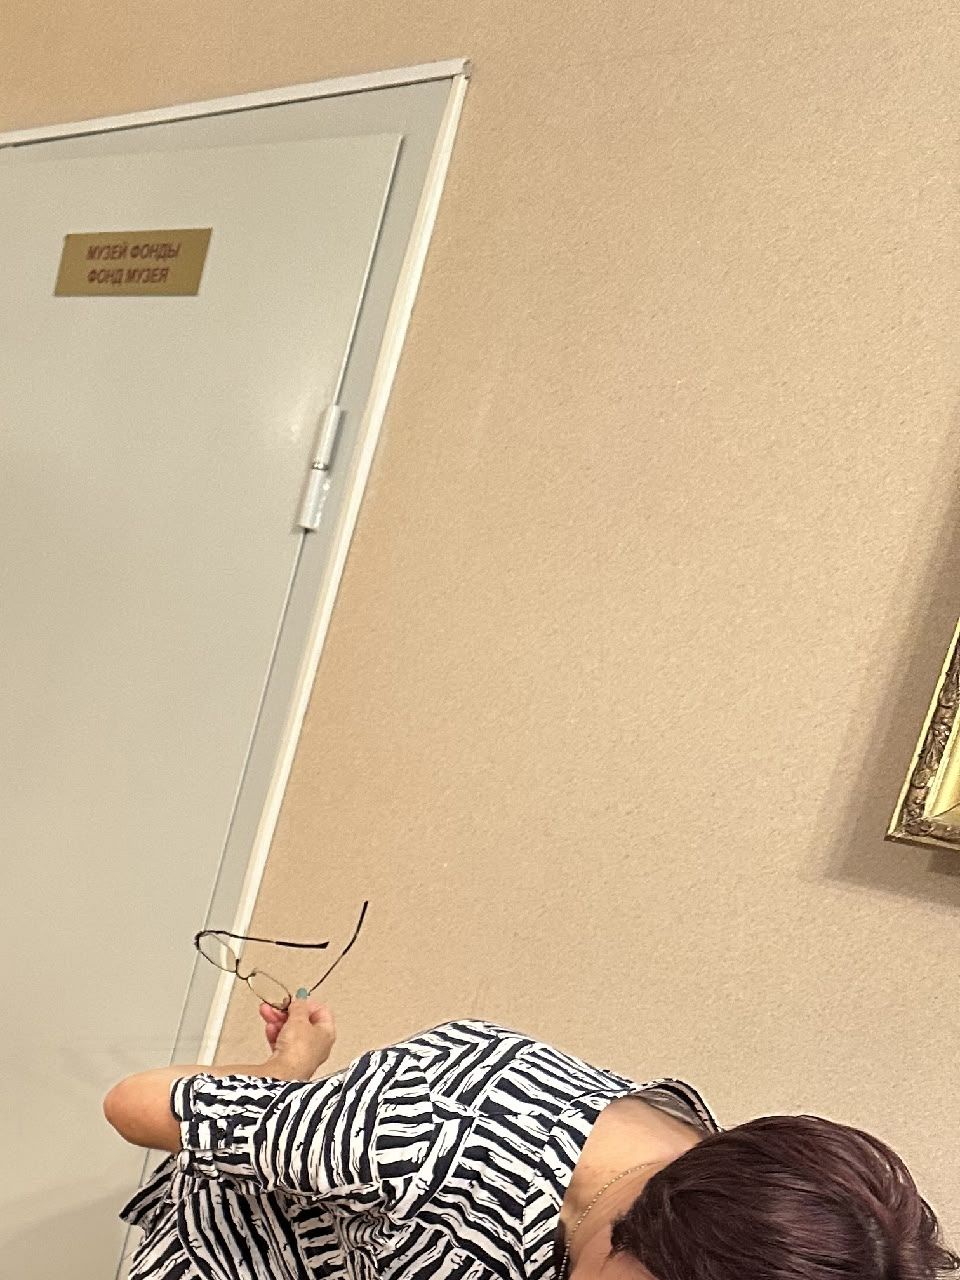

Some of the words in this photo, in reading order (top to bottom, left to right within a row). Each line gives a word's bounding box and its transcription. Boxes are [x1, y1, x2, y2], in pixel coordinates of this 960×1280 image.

[86, 242, 128, 260] МУЗЕЙ
[130, 243, 180, 261] ФОНДЫ
[87, 268, 123, 285] ФОНД
[125, 268, 169, 283] МУЗЕЯ
